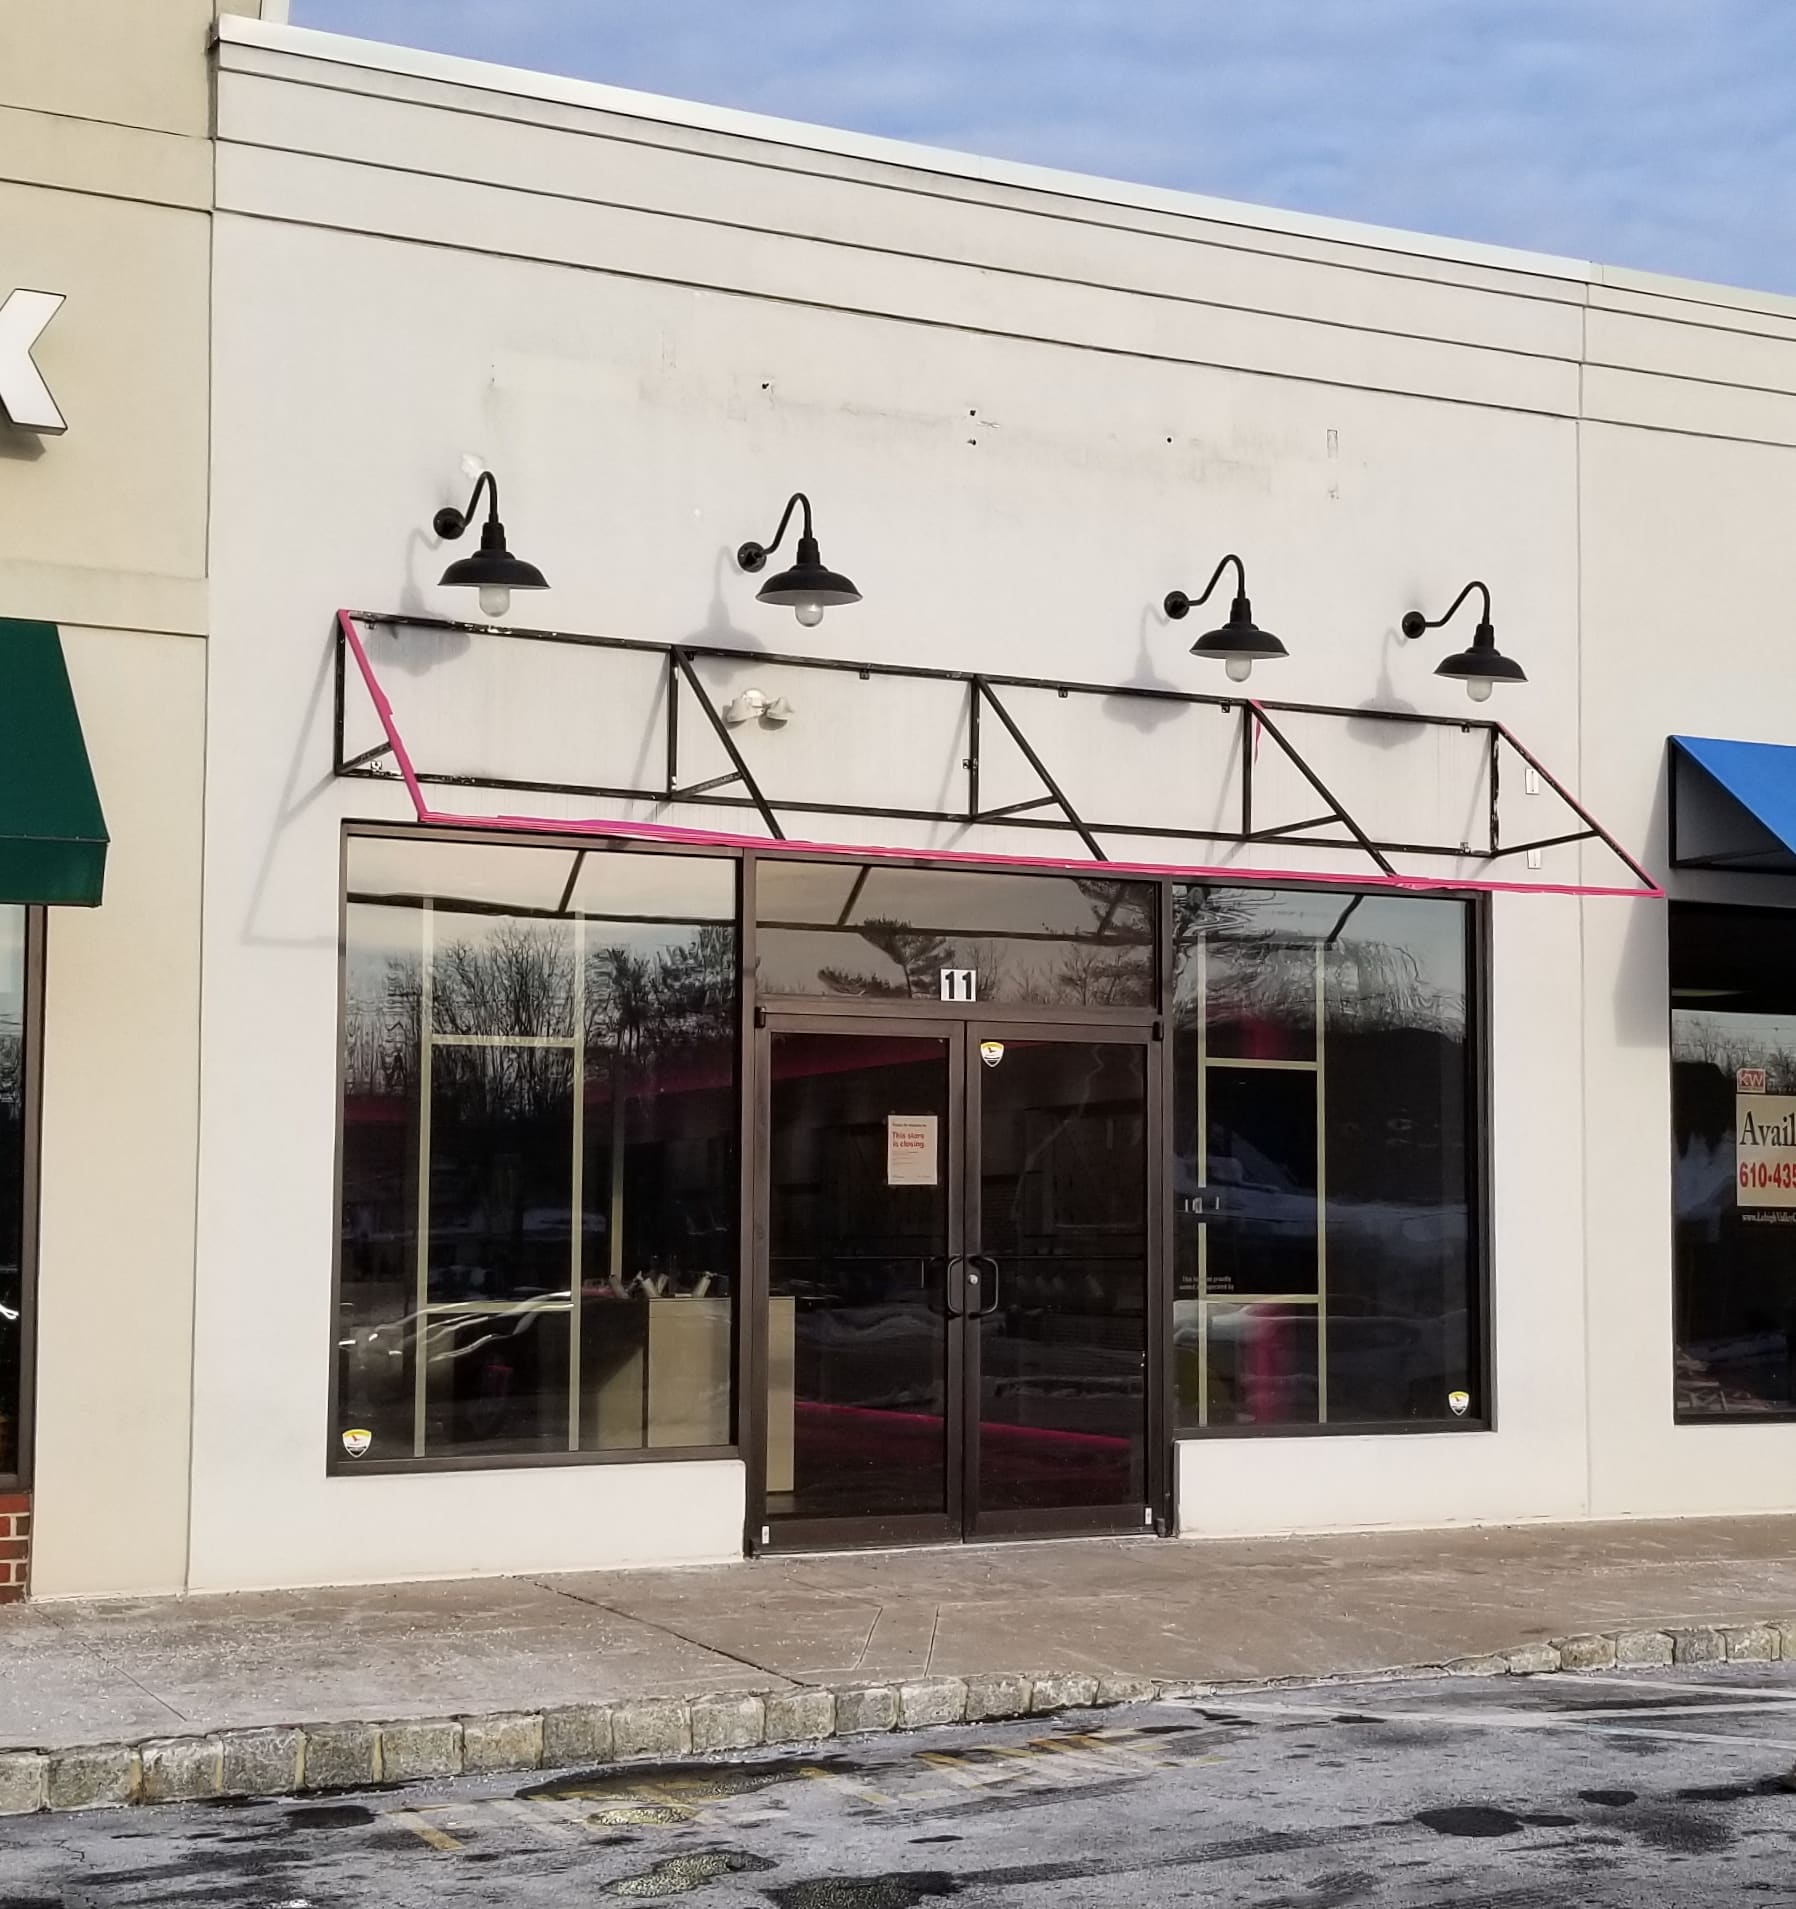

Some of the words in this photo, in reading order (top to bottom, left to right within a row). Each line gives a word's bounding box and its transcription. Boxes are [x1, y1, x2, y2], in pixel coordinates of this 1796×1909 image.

[945, 971, 973, 1000] 11
[1739, 1072, 1763, 1086] KW
[892, 1131, 906, 1139] This
[908, 1132, 924, 1140] store
[1739, 1110, 1796, 1147] Avail
